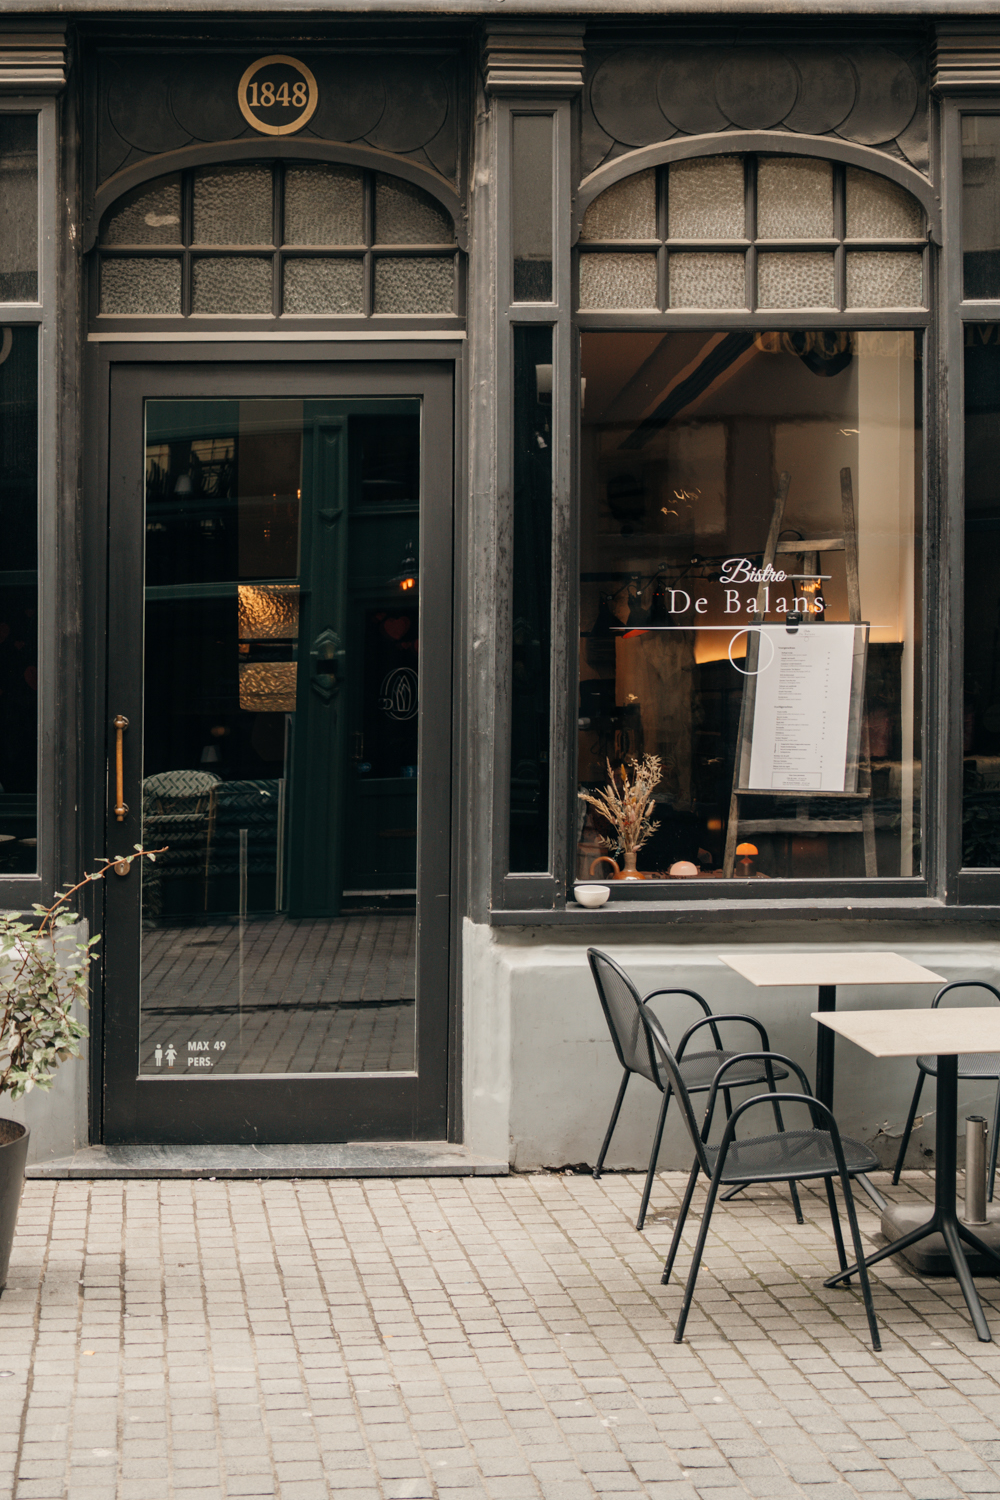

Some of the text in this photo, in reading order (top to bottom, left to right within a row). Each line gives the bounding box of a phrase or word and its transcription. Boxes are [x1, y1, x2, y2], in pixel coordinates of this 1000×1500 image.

[248, 81, 307, 107] 1848
[719, 558, 788, 584] Bistro
[668, 586, 824, 614] De Balans
[187, 1040, 227, 1051] MAX 49
[187, 1056, 214, 1067] PERS.
